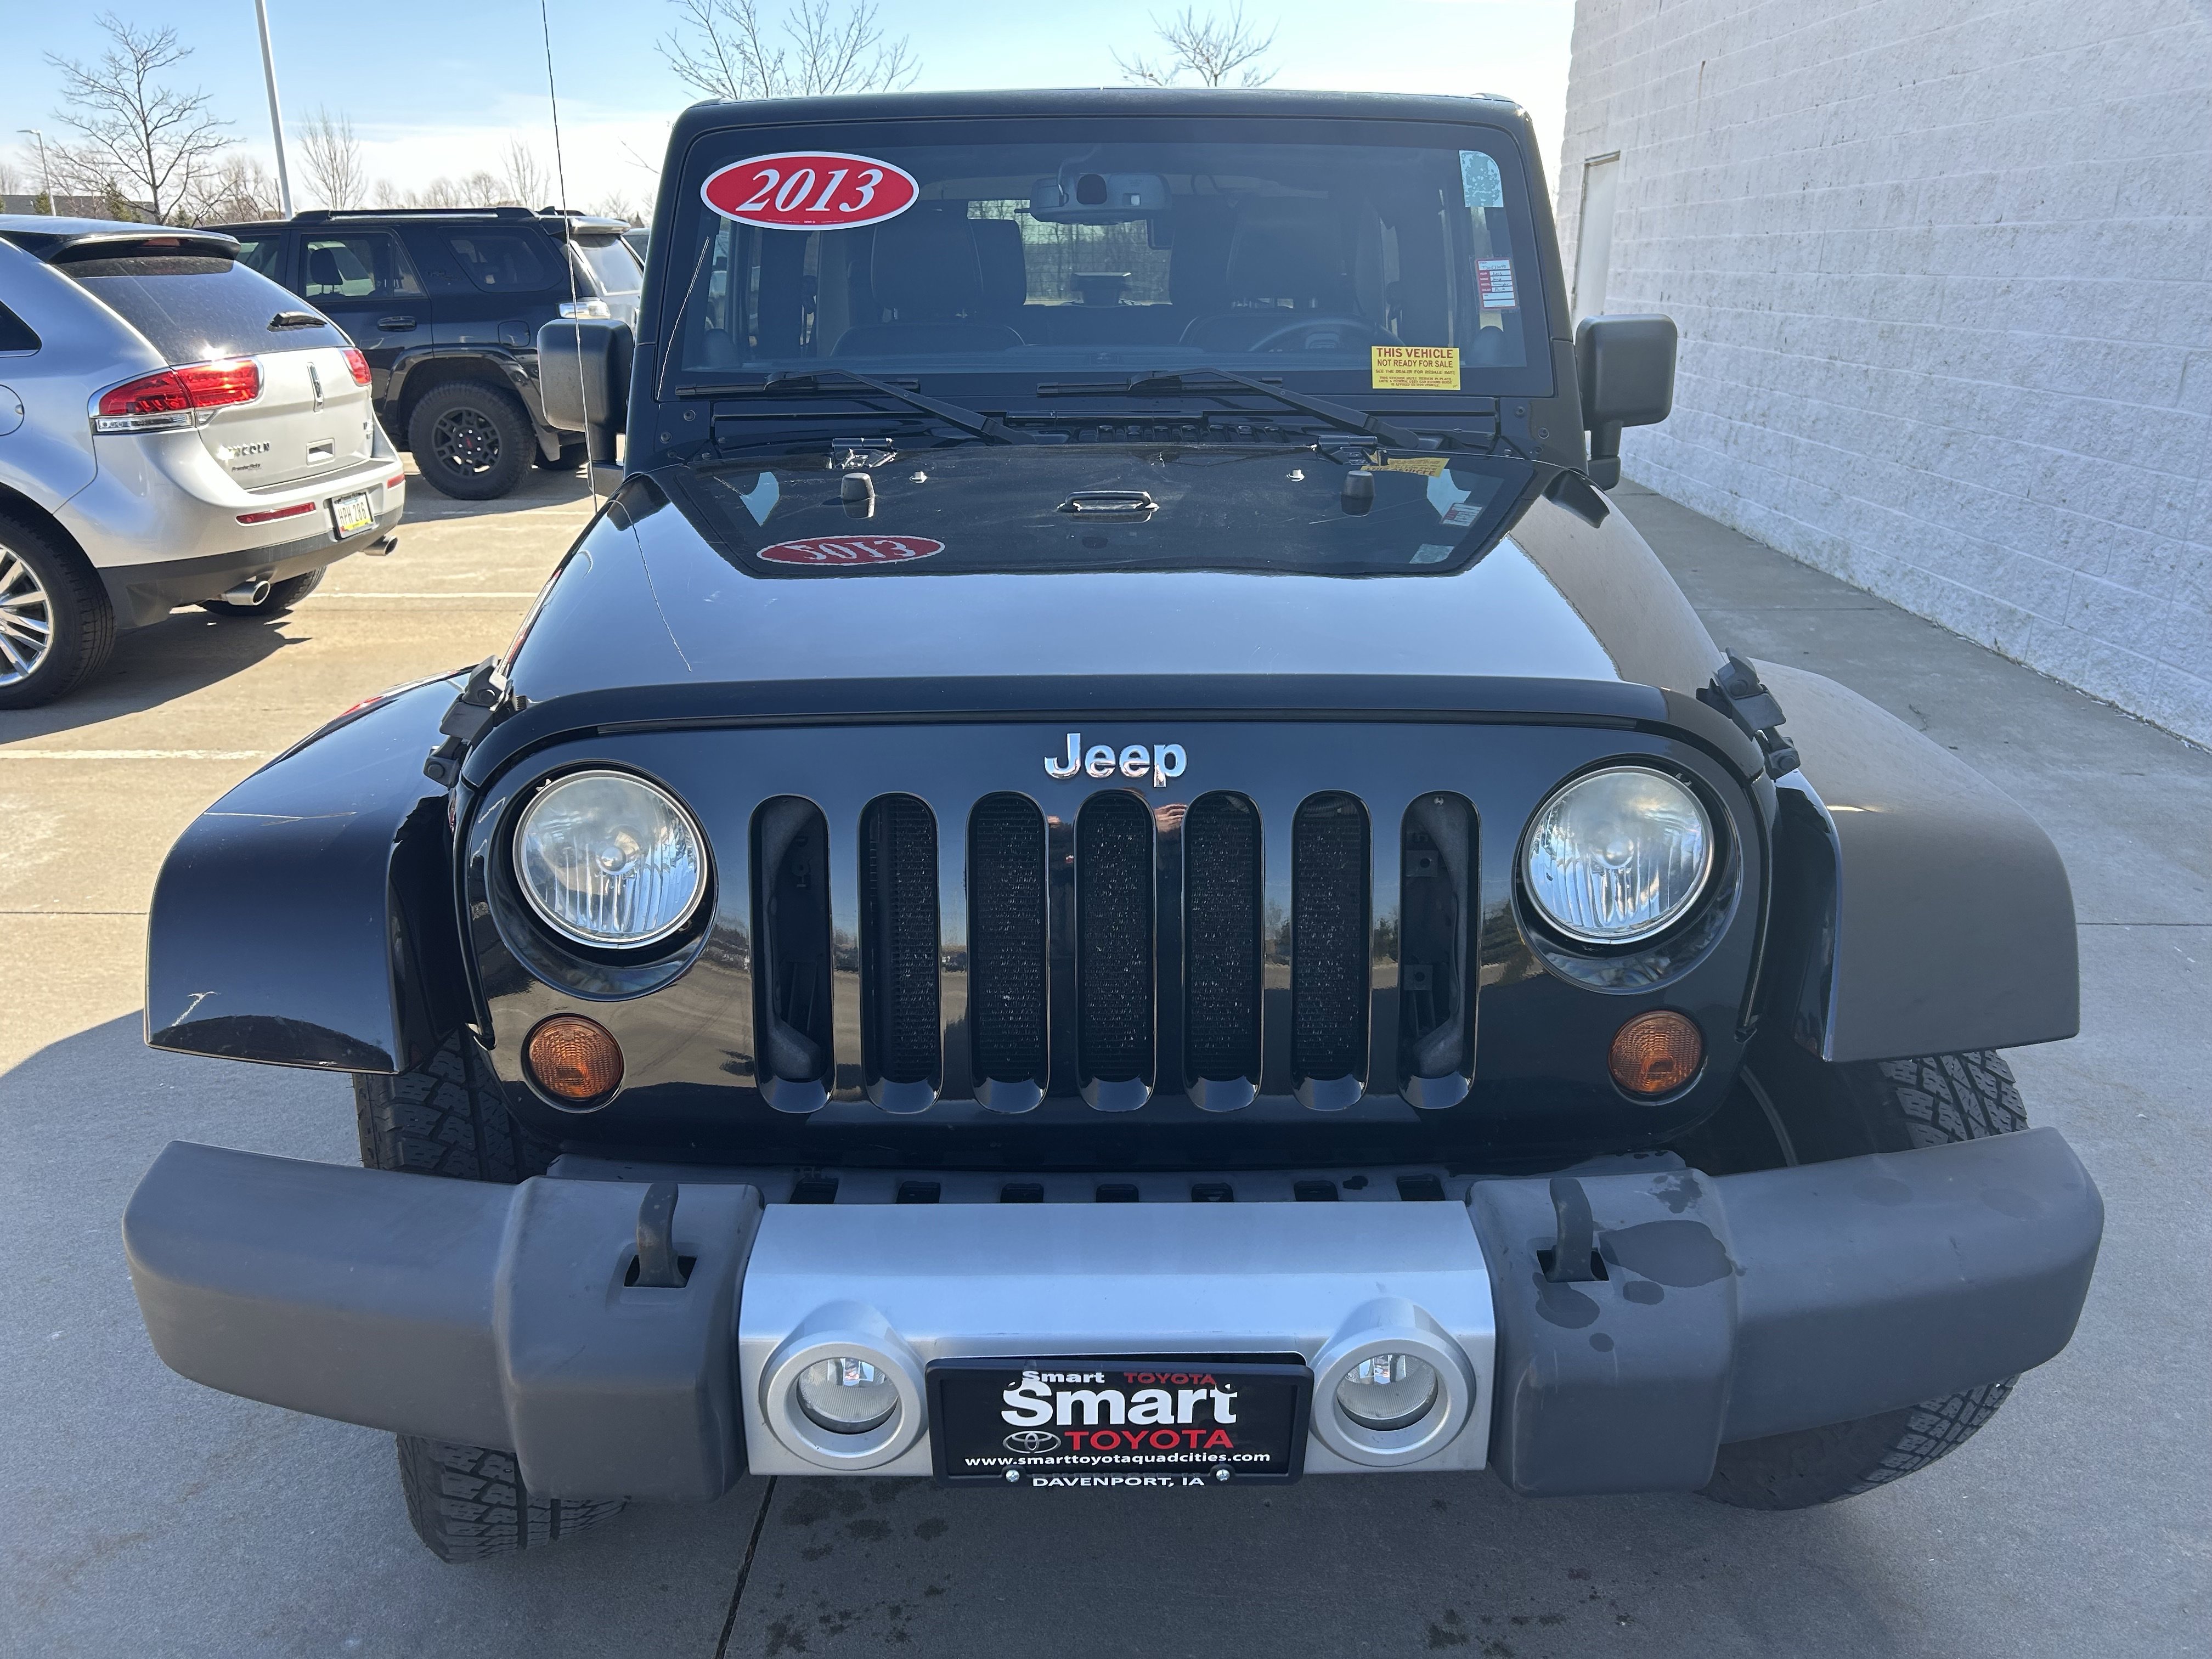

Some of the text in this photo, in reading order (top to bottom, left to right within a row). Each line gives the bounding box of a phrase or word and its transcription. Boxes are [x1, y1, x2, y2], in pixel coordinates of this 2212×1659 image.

[735, 168, 883, 212] 2013
[1376, 347, 1453, 359] THIS VEHICLE
[1393, 359, 1418, 368] READY
[1435, 360, 1453, 368] SALE
[338, 501, 366, 527] HPH 286
[1044, 732, 1188, 788] Jeep
[1022, 1370, 1216, 1385] Smart TOYOTA
[1001, 1380, 1238, 1427] Smart
[1064, 1429, 1234, 1451] TOYOTA
[964, 1452, 1271, 1466] www.smarttoyotaquadcities.com
[1032, 1476, 1205, 1487] DAVENPORT, IA
